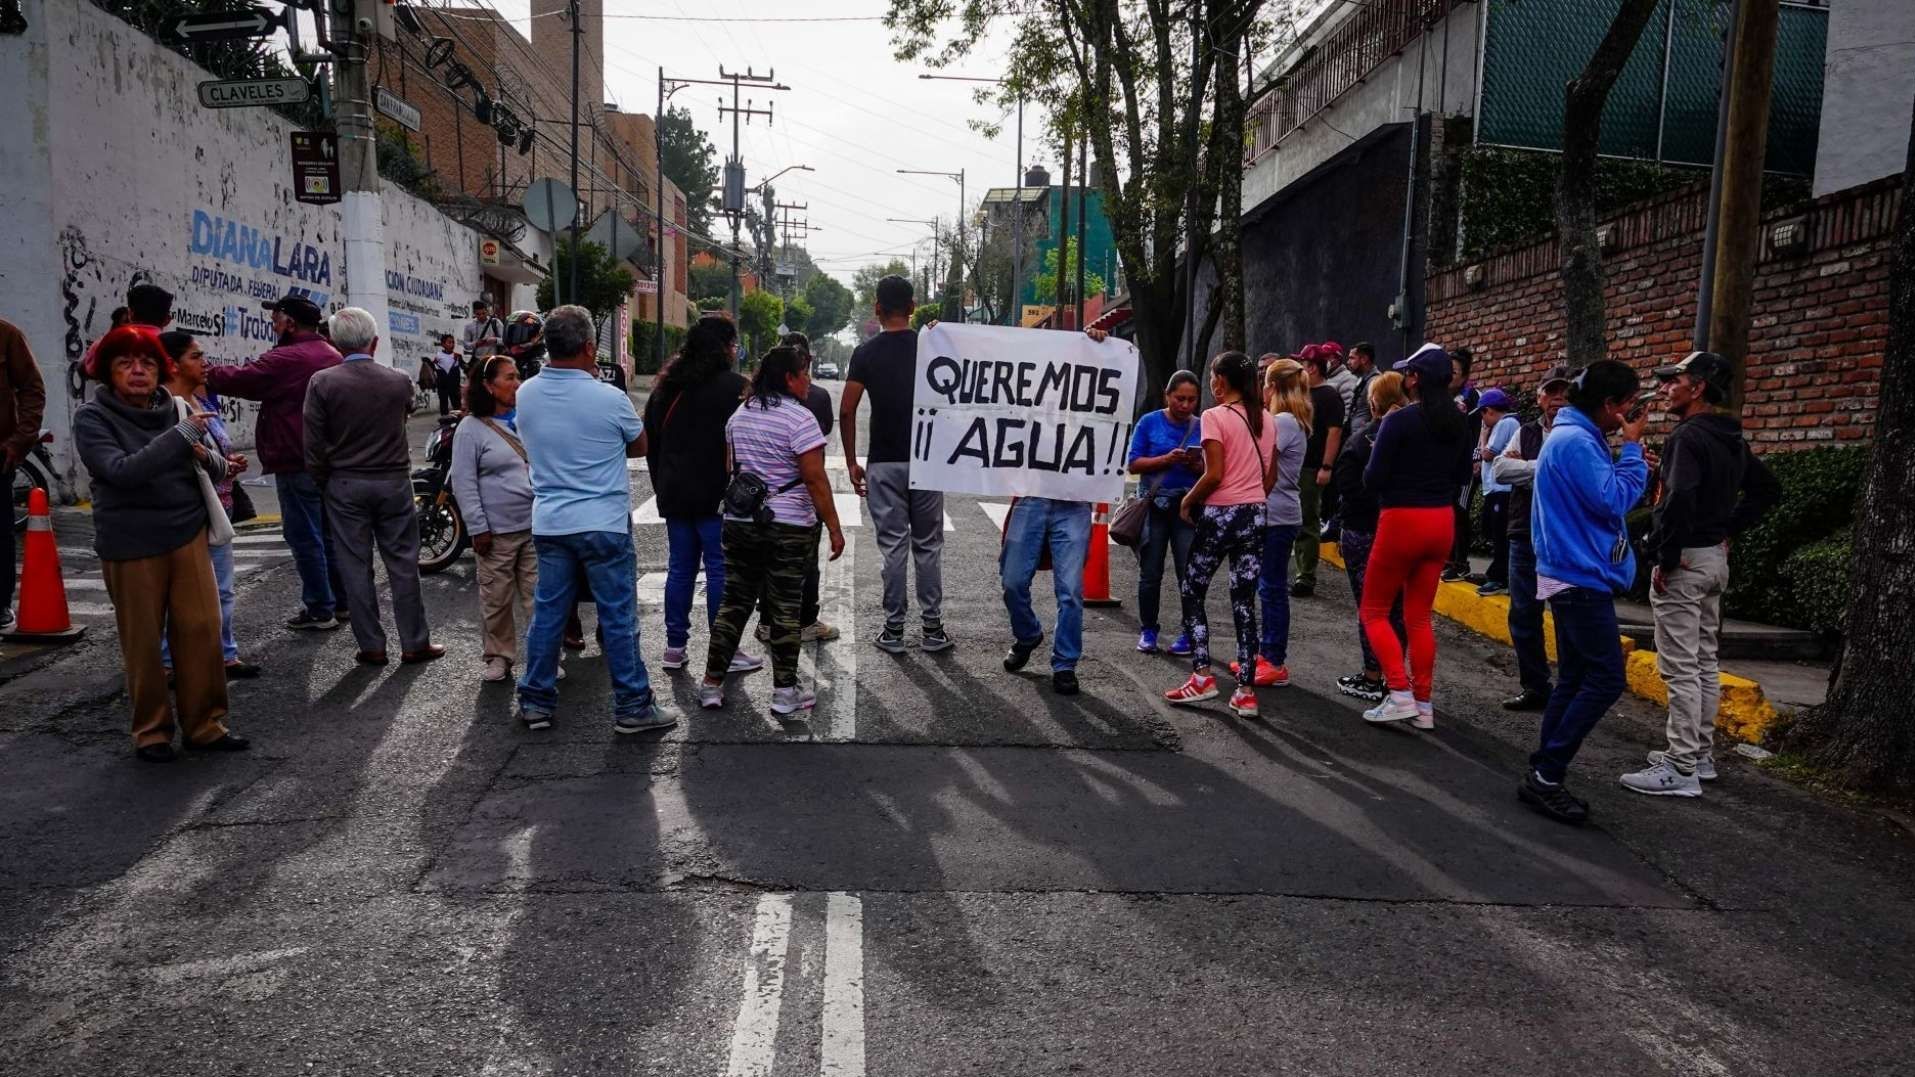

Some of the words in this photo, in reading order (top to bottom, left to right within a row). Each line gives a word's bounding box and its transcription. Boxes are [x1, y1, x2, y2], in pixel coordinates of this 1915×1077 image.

[210, 84, 284, 101] CLAVELES
[192, 266, 243, 293] DIPUTADA
[926, 356, 1122, 415] QUEREMOS
